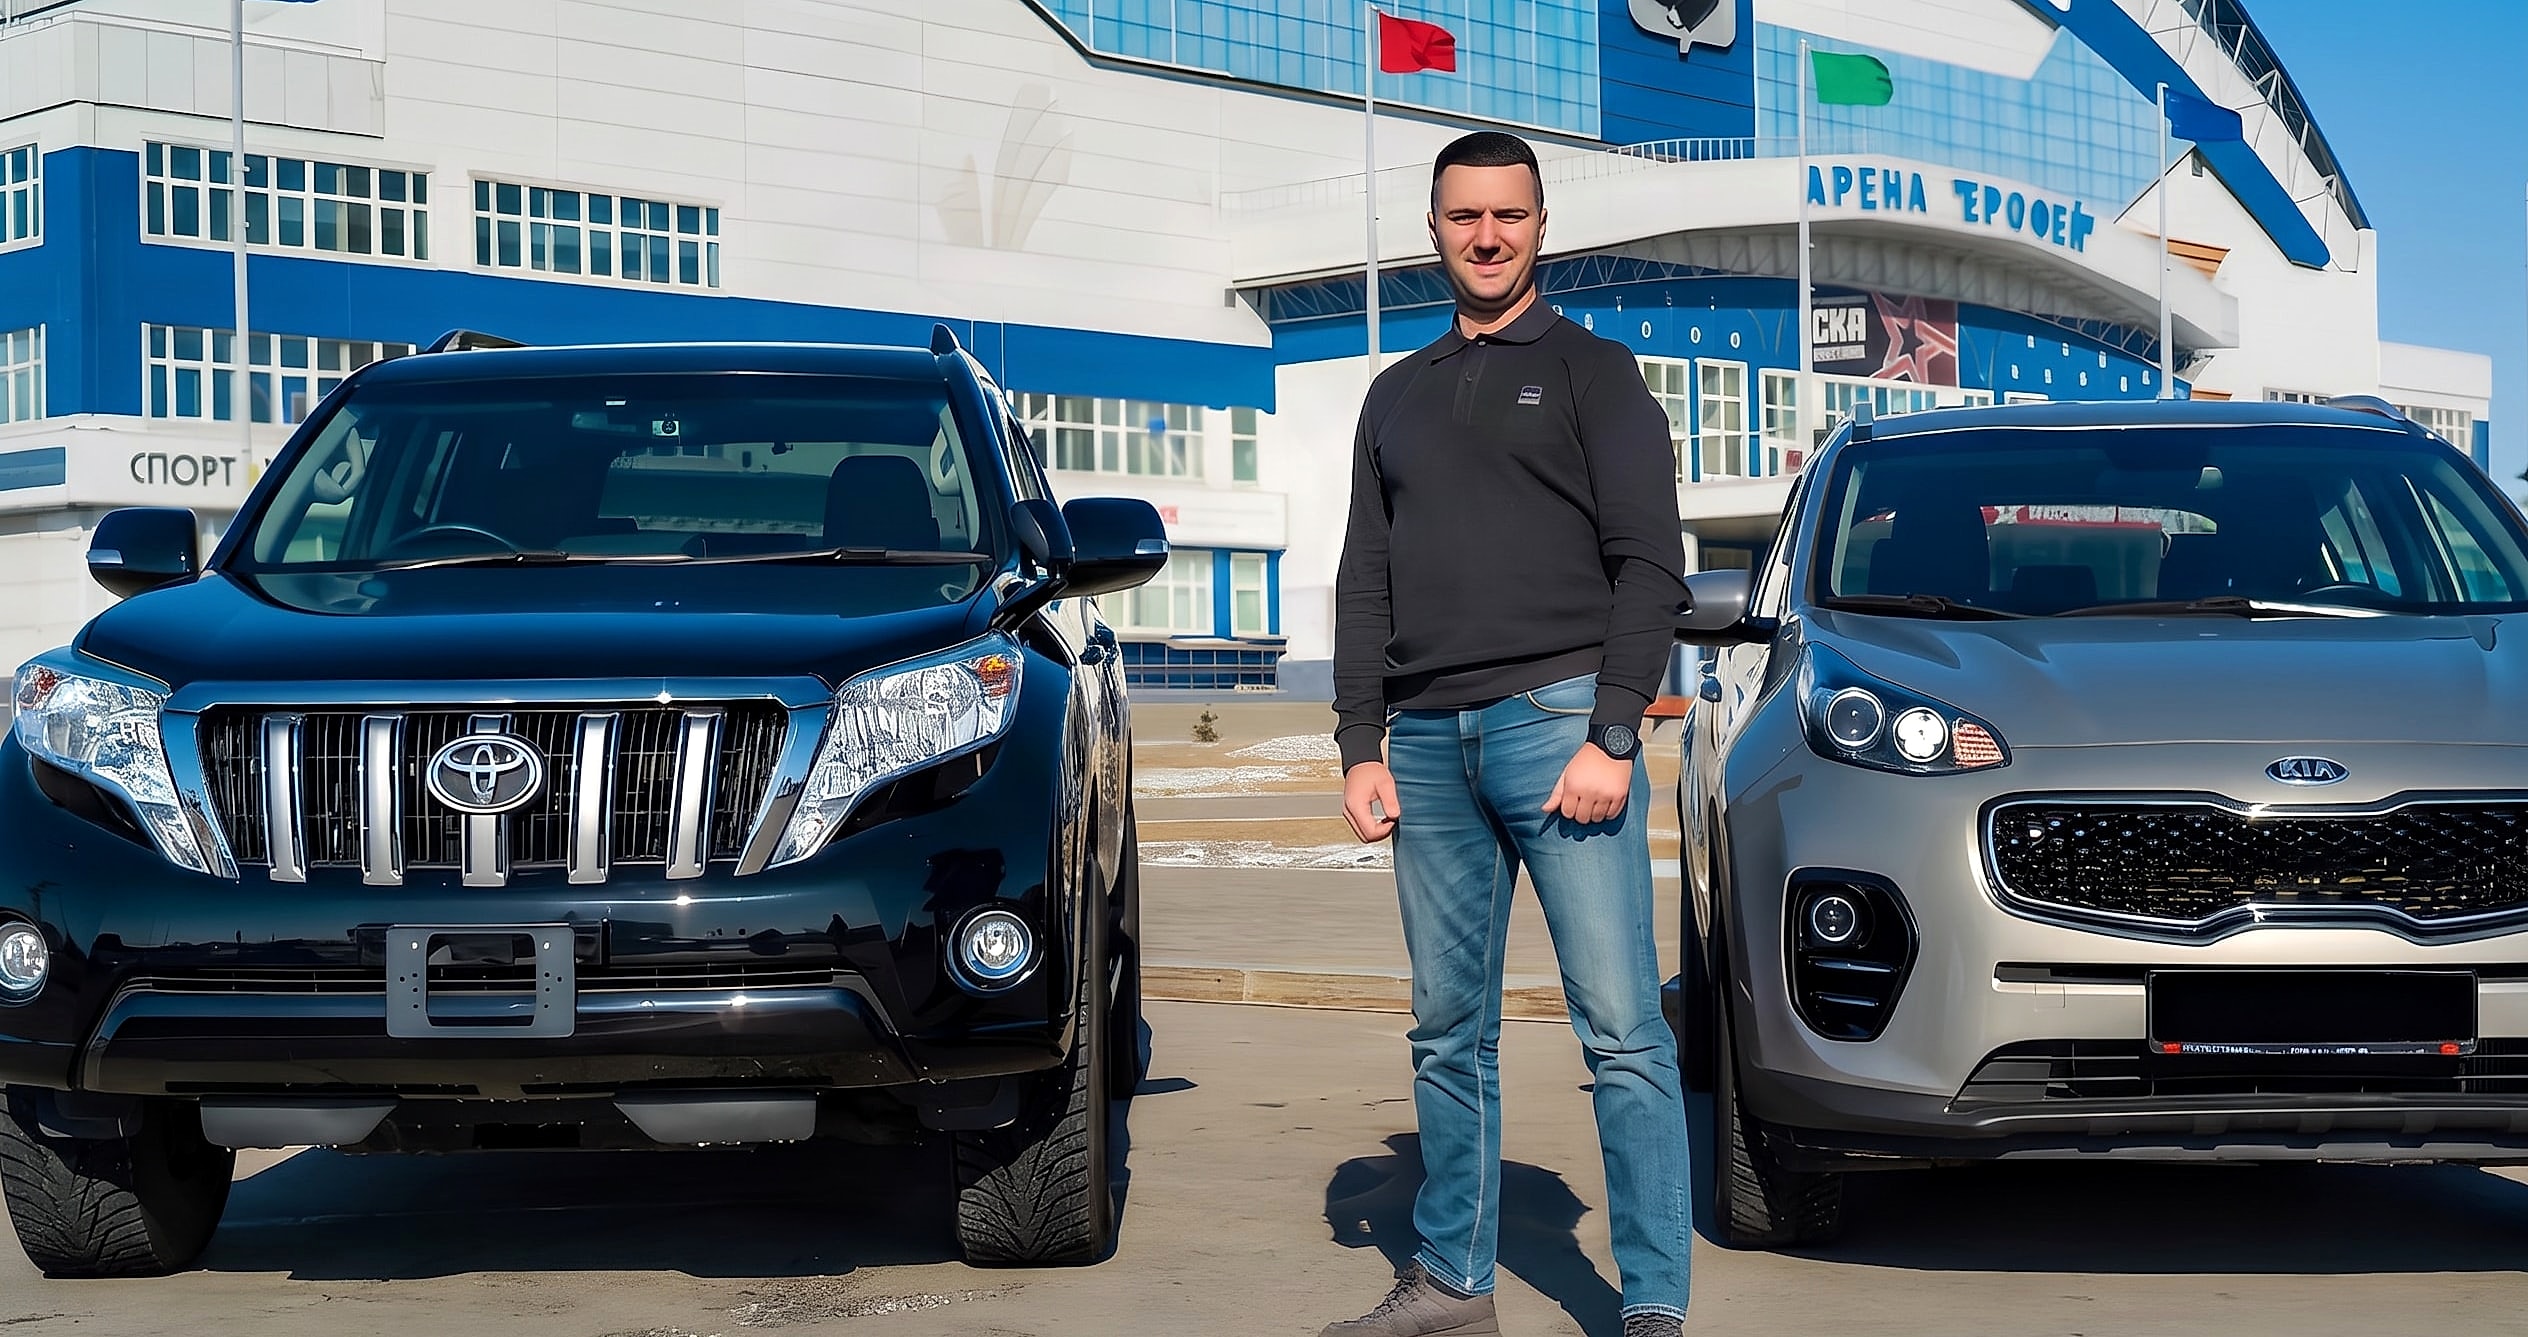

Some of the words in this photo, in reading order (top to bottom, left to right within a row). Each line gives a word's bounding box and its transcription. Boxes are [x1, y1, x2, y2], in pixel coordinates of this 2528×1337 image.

[1807, 165, 1927, 213] АРЕНА
[1812, 307, 1867, 344] СКА
[130, 452, 236, 486] СПОРТ
[2279, 759, 2337, 778] KIA
